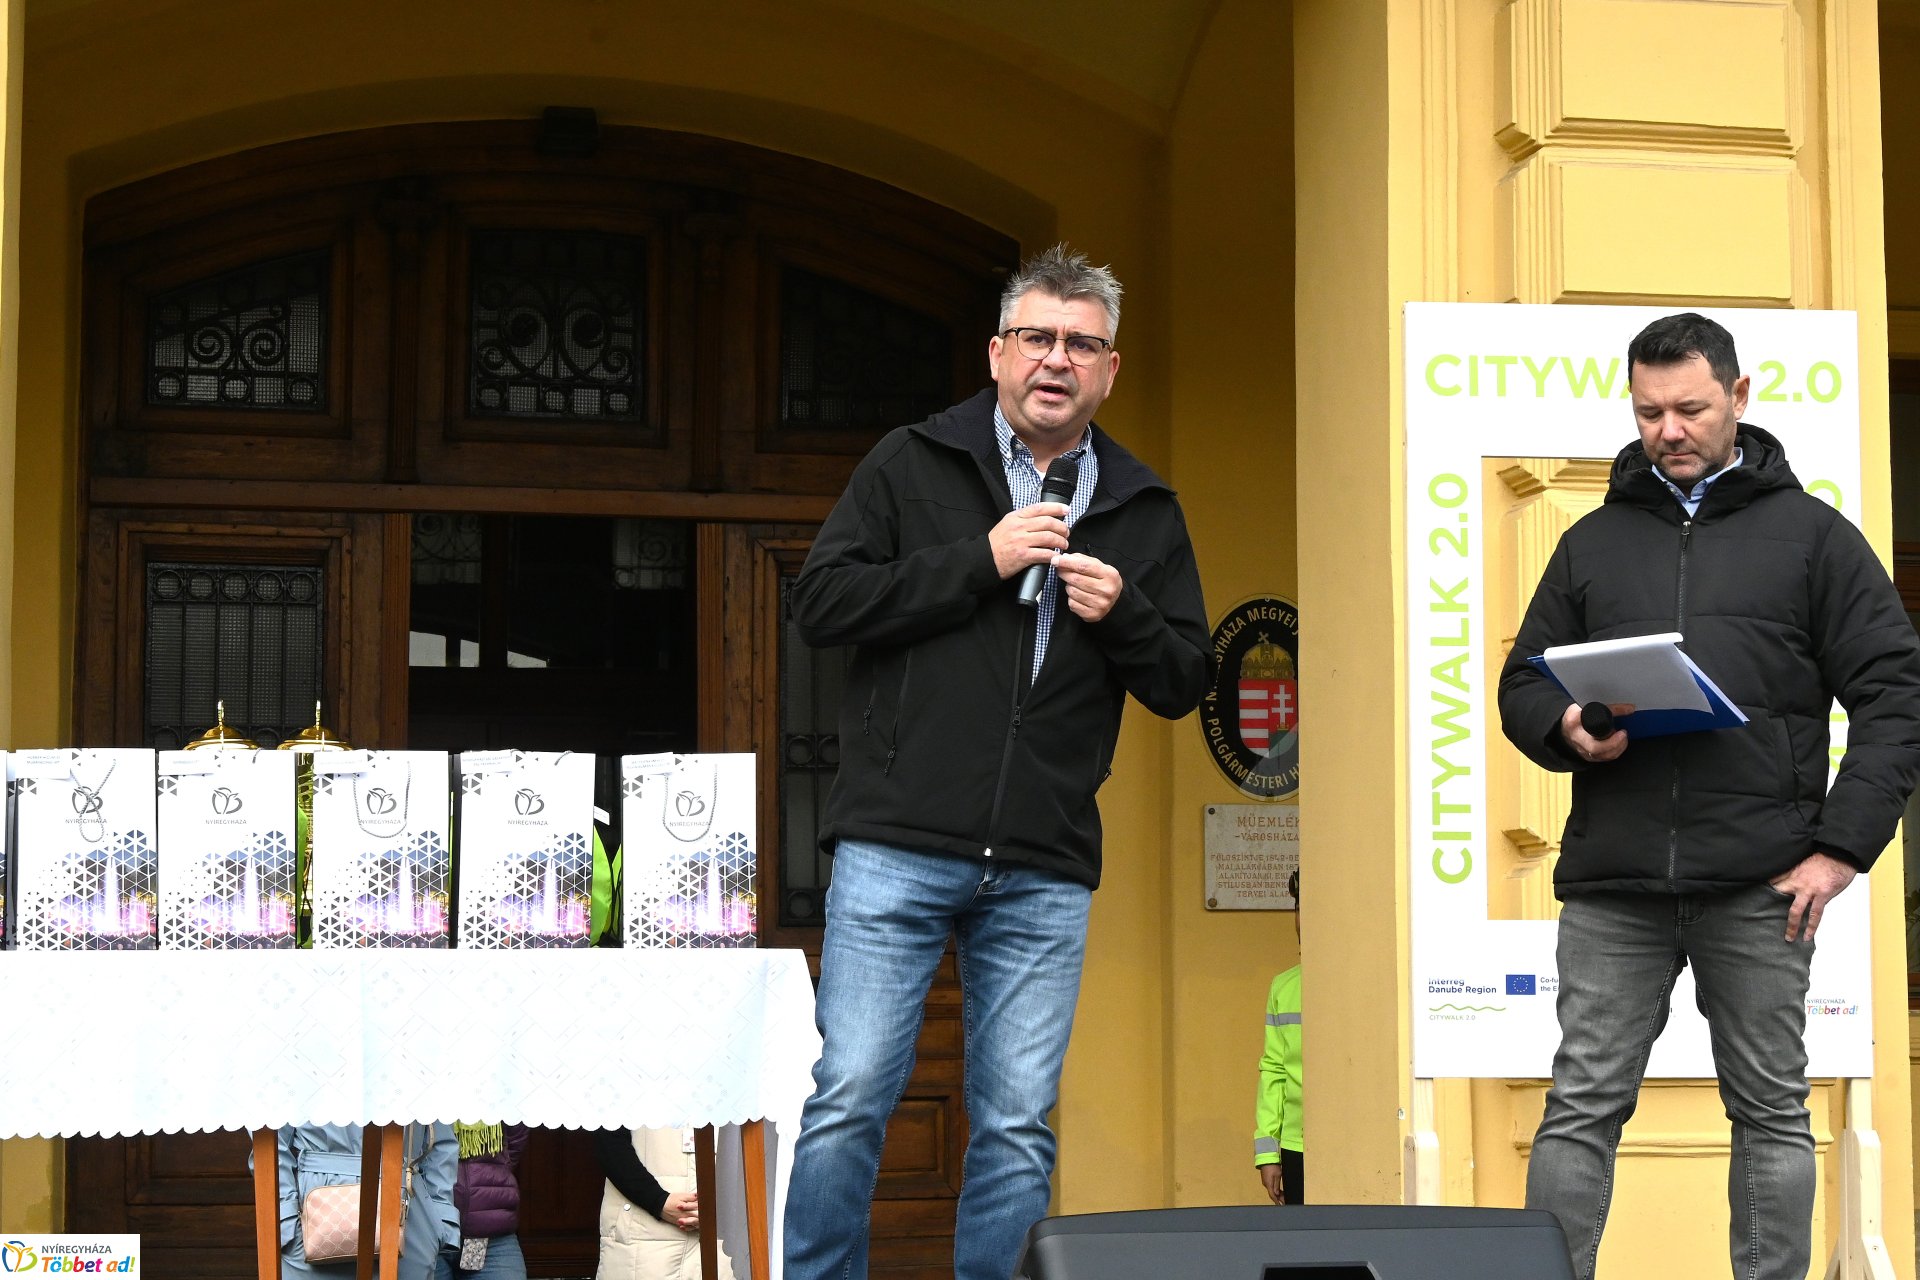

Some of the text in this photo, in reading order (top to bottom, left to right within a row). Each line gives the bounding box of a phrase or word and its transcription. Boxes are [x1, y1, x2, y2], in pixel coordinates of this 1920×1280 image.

[1425, 354, 1842, 403] CITYW 2.0
[1247, 606, 1297, 629] MEGYEI
[1428, 473, 1472, 884] CITYWALK 2.0
[1207, 717, 1289, 789] POLGÁRMESTERI
[1428, 977, 1465, 986] Interreg
[1428, 986, 1497, 995] Danube Region
